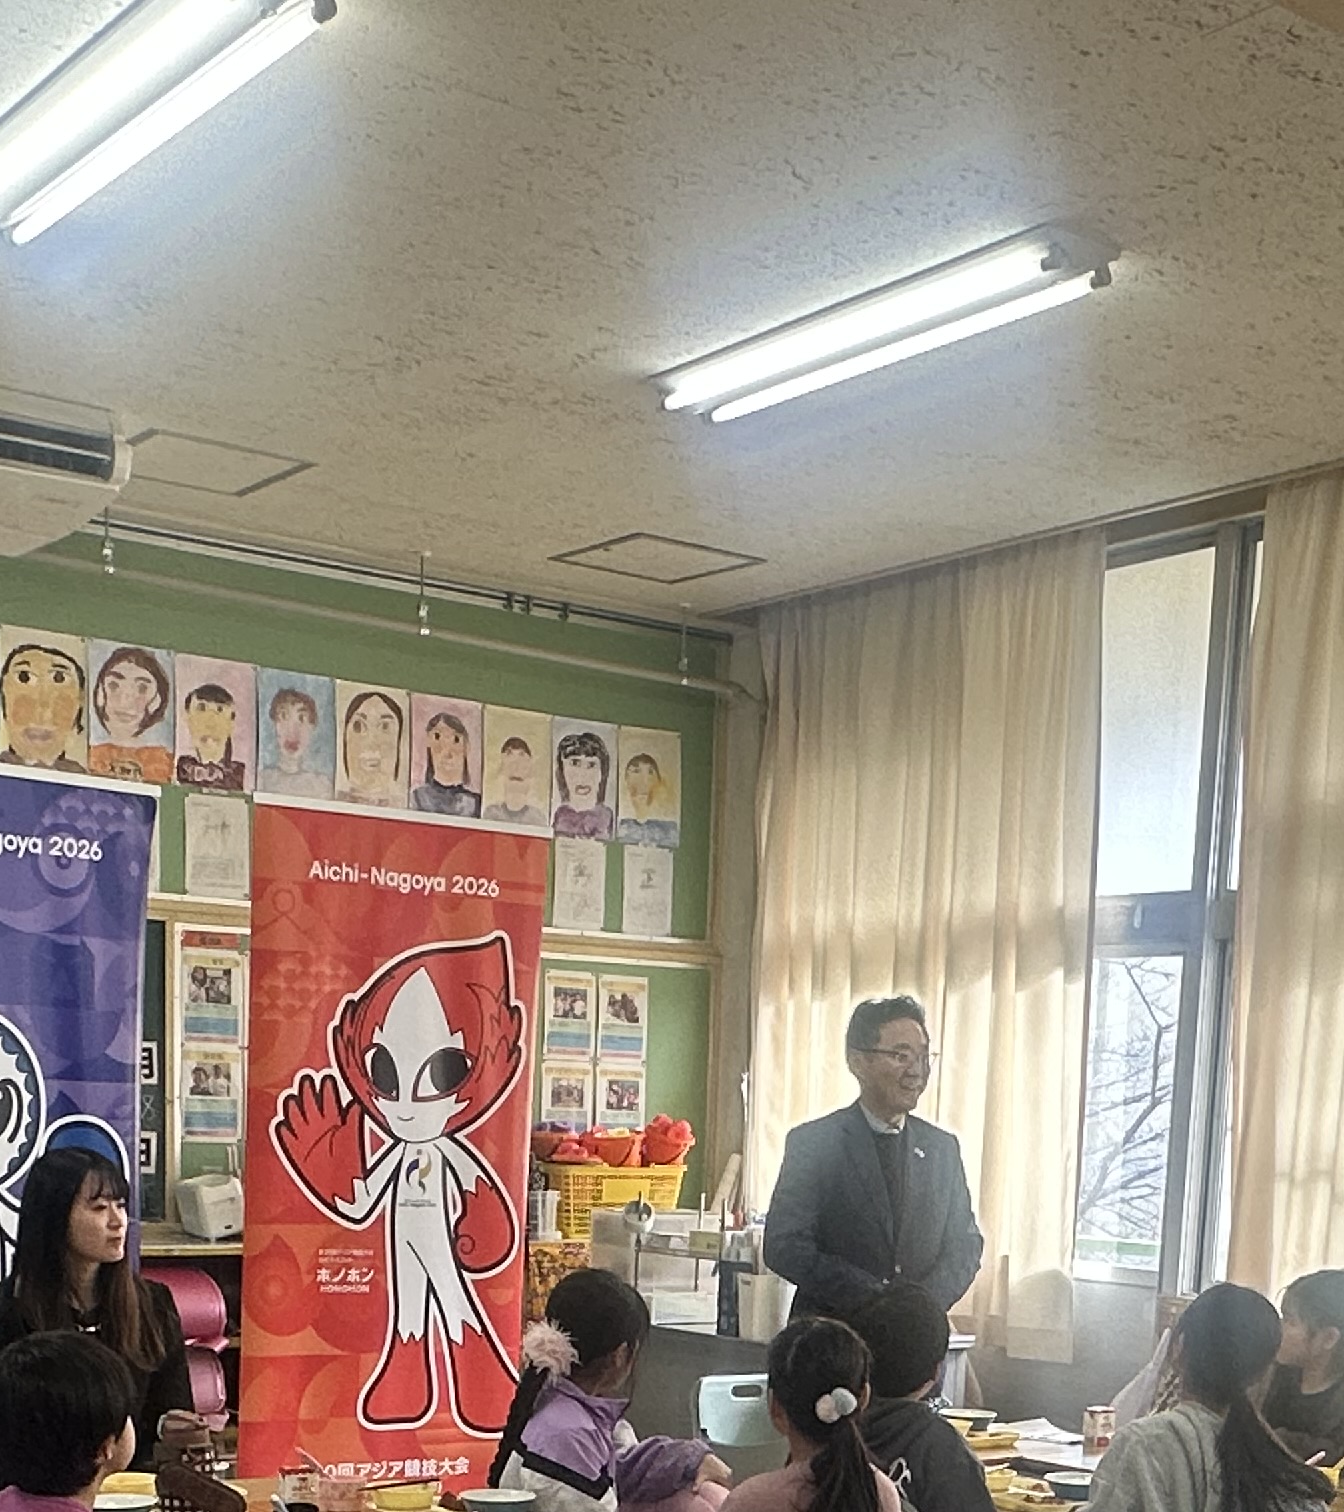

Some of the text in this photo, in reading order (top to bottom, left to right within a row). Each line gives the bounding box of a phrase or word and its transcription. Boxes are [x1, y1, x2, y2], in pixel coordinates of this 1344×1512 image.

[48, 836, 104, 862] 2026
[308, 858, 500, 898] Aichi-Nagoya 2026
[316, 1266, 375, 1283] ホノホン
[322, 1456, 470, 1479] 0回アジア競技大会
